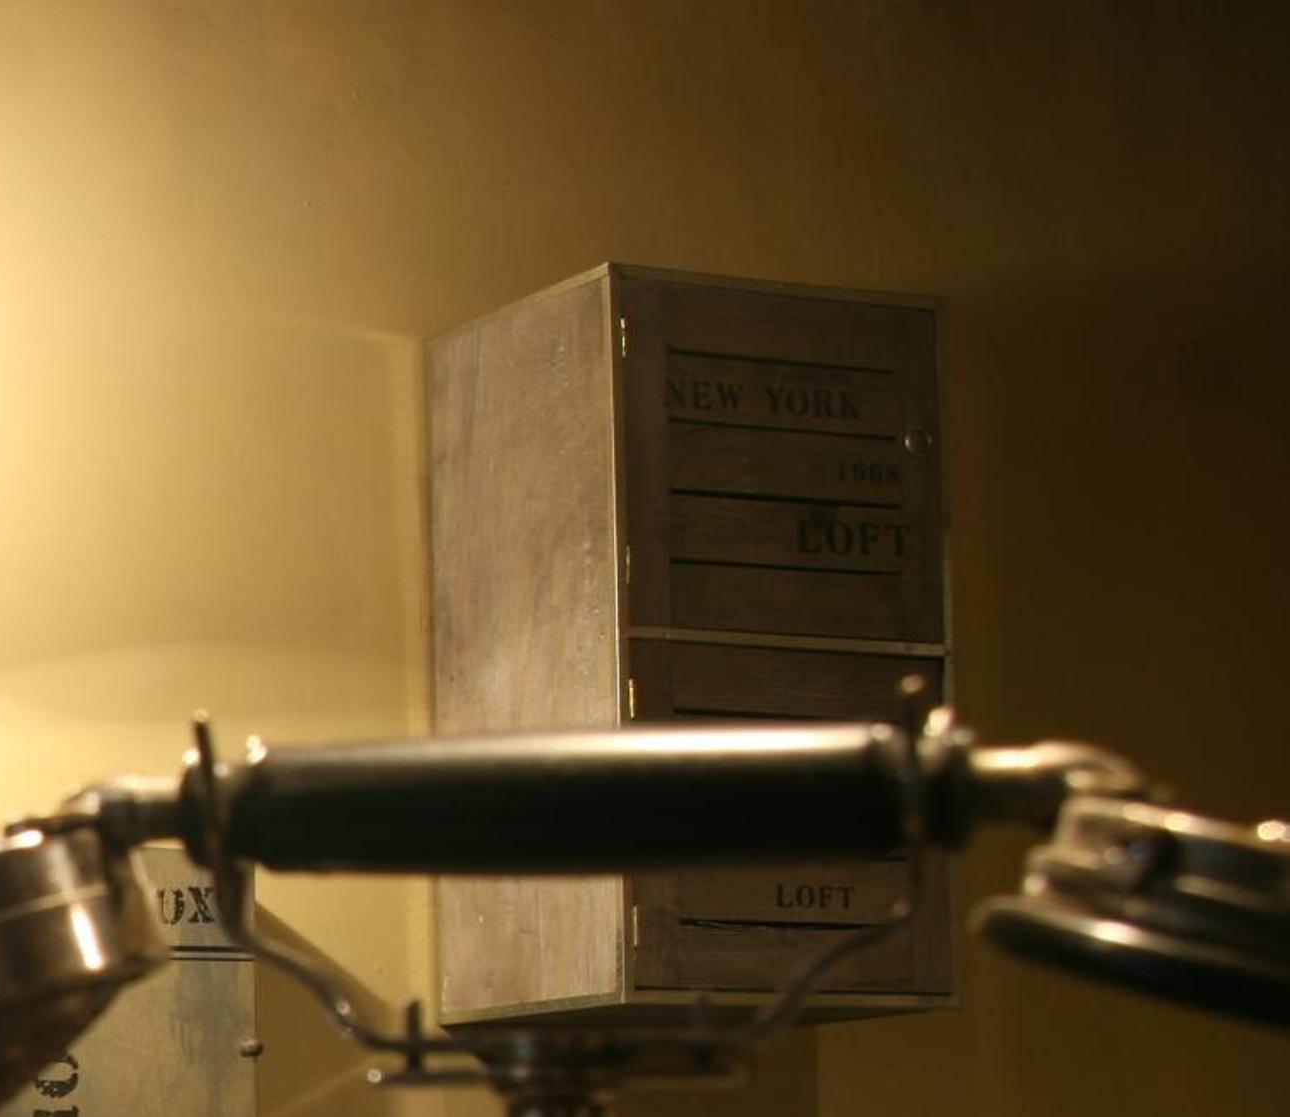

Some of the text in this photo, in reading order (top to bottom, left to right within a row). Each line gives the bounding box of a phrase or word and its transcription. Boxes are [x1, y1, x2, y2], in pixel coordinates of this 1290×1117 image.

[664, 377, 859, 418] NEW YORK
[796, 519, 911, 557] LOFT
[775, 882, 857, 911] LOFT
